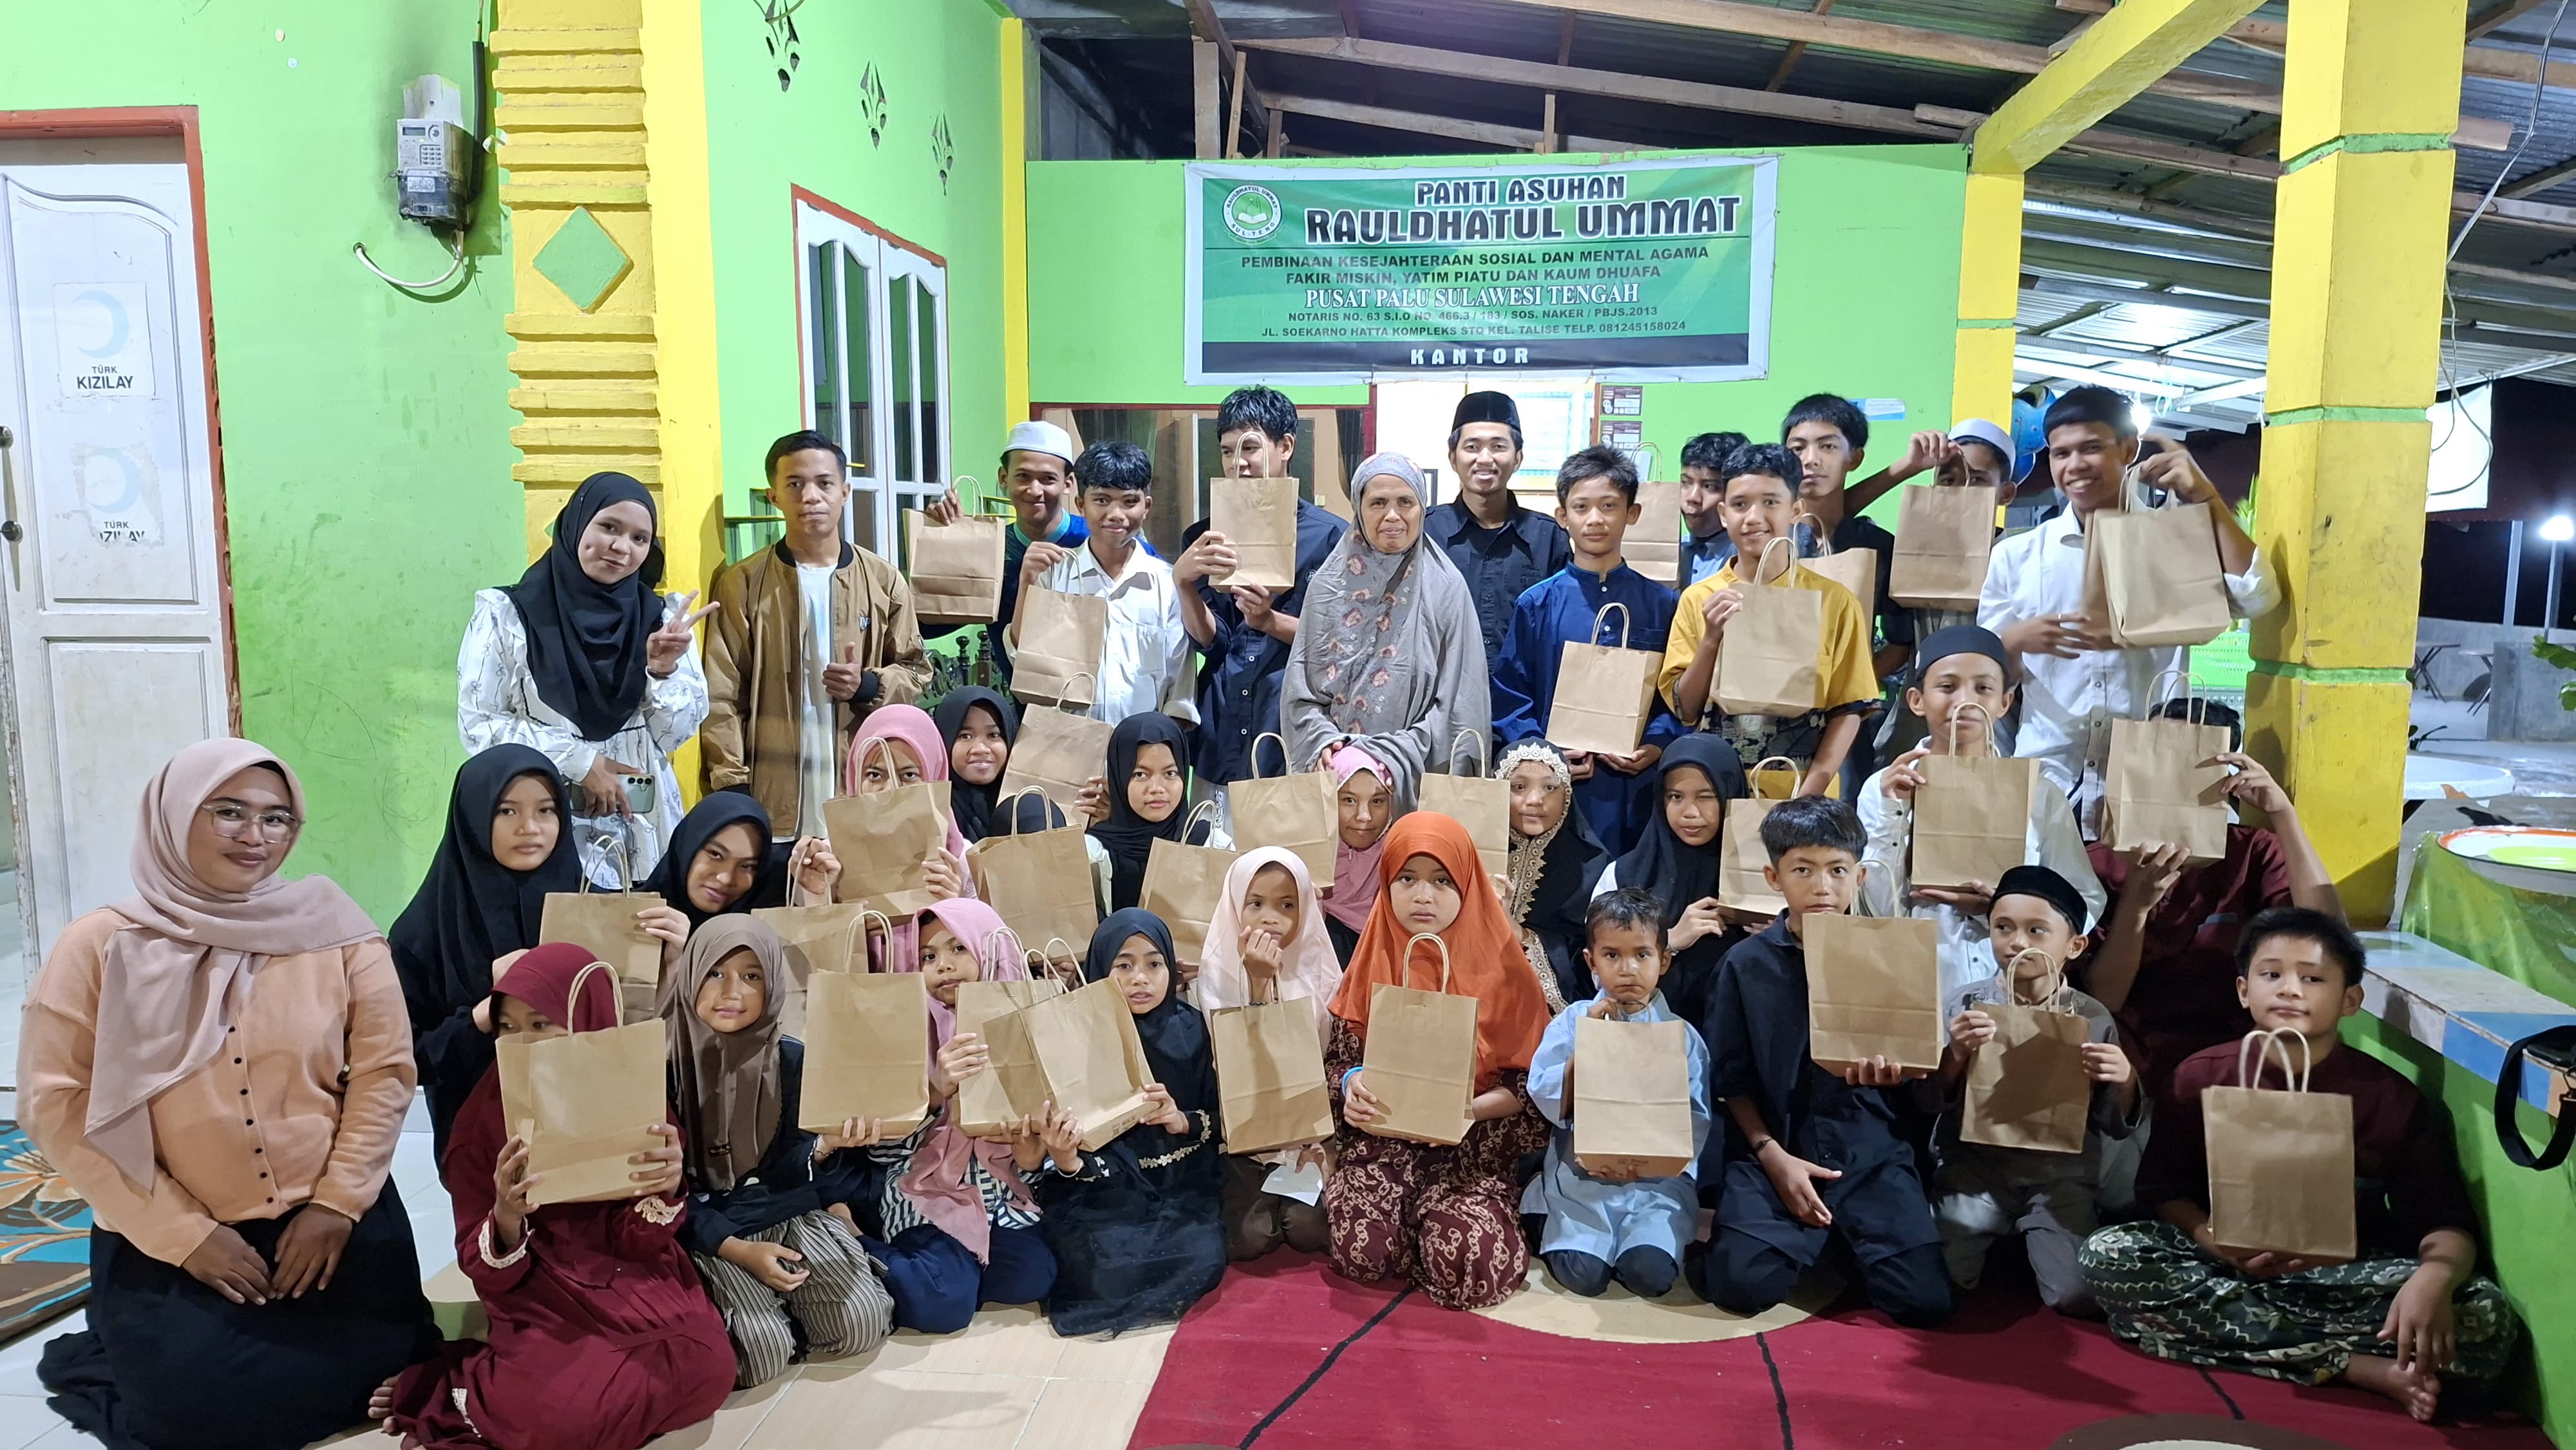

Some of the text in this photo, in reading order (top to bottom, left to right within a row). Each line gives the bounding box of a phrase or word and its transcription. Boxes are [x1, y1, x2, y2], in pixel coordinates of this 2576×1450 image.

[1416, 174, 1626, 206] PANTI ASUHAN
[1305, 196, 1741, 244] RAULDHATUL UMMAT
[1242, 246, 1709, 268] PEMBINAAN KESEJAHTERAAN SOSIAL DAN MENTAL AGAMA
[1287, 265, 1661, 286] FAKIR MISKIN, YATIM PIATU DAN KAUM DHUAFA
[1305, 282, 1640, 308] PUSAT PALU SULAWESI TENGAH
[1289, 312, 1339, 321] NOTARIS
[1343, 312, 1363, 321] NO.
[1367, 312, 1380, 321] 63
[1384, 312, 1410, 321] S.I.O
[1438, 312, 1470, 321] 466.3
[1511, 310, 1538, 319] SOS.
[1542, 308, 1584, 319] NAKER
[1595, 306, 1658, 317] PBJS.2013
[1262, 321, 1686, 337] JL. SOEKARNO HATTA KOMPLEKS STQ KEL. TALISE TELP. 081245158024
[1410, 348, 1529, 366] KANTOR
[91, 364, 118, 373] TÜRK
[77, 375, 133, 389] KIZILAY
